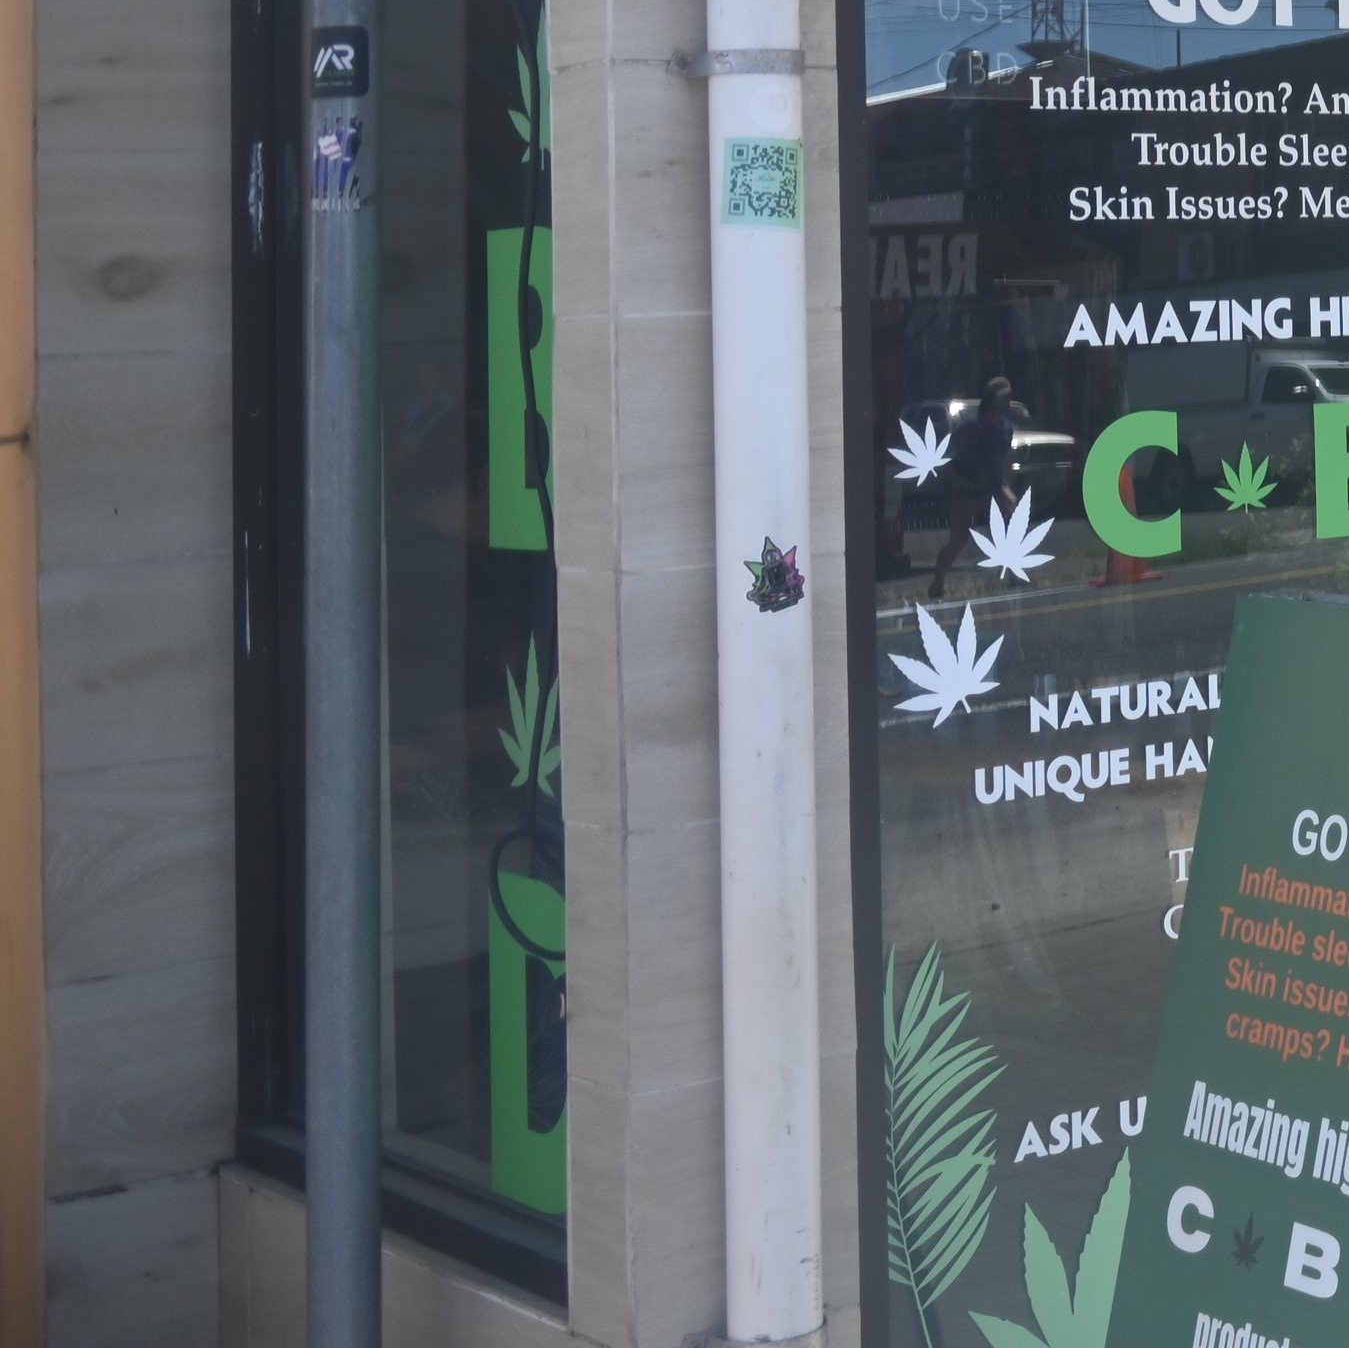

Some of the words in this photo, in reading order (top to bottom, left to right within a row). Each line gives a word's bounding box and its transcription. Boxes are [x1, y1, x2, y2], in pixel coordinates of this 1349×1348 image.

[937, 51, 1018, 85] CBD
[1029, 76, 1293, 114] Inflammation?
[1131, 132, 1267, 166] Trouble
[1069, 185, 1155, 221] Skin
[1166, 186, 1289, 220] Issues?
[1063, 296, 1292, 348] AMAZING
[1082, 409, 1182, 558] C
[975, 748, 1130, 804] UNIQUE
[1219, 906, 1306, 956] Trouble
[1225, 956, 1278, 999] Skin
[1226, 1013, 1331, 1062] cramps?
[1014, 1106, 1103, 1163] ASK
[1183, 1080, 1310, 1178] Amazing
[1167, 1186, 1214, 1253] C
[1284, 1222, 1341, 1298] B
